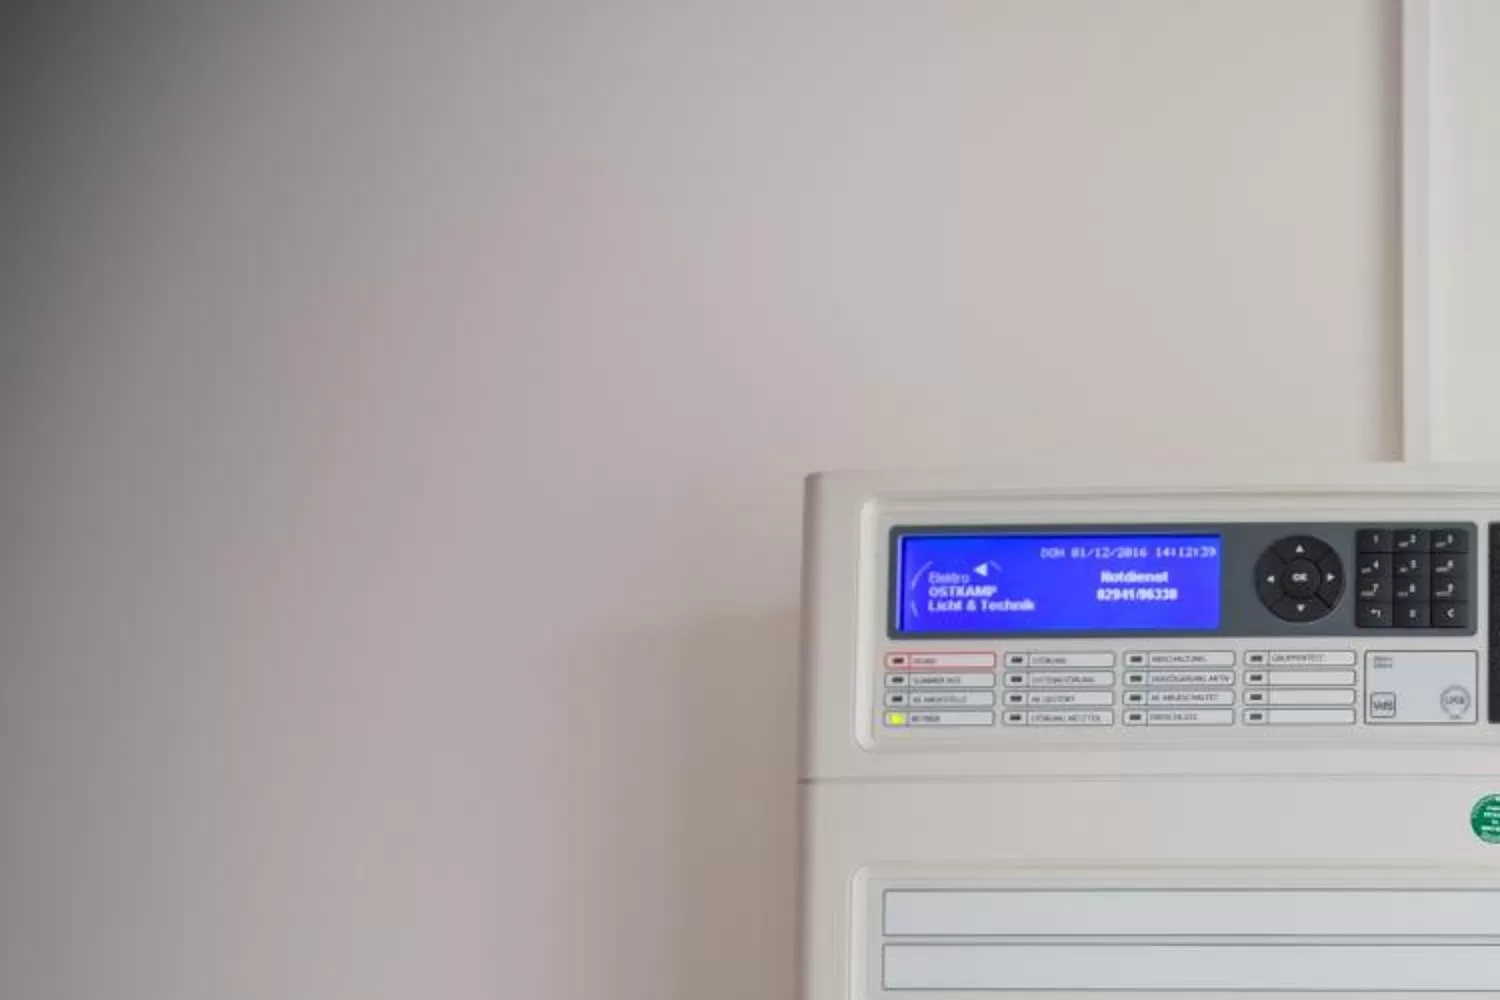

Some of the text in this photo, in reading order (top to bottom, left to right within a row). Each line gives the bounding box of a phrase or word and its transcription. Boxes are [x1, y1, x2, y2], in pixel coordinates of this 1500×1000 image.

[1101, 571, 1168, 583] Notdienst
[1292, 573, 1307, 582] OK
[928, 585, 997, 597] OSTKAMP
[928, 598, 1035, 611] Licht & Technik
